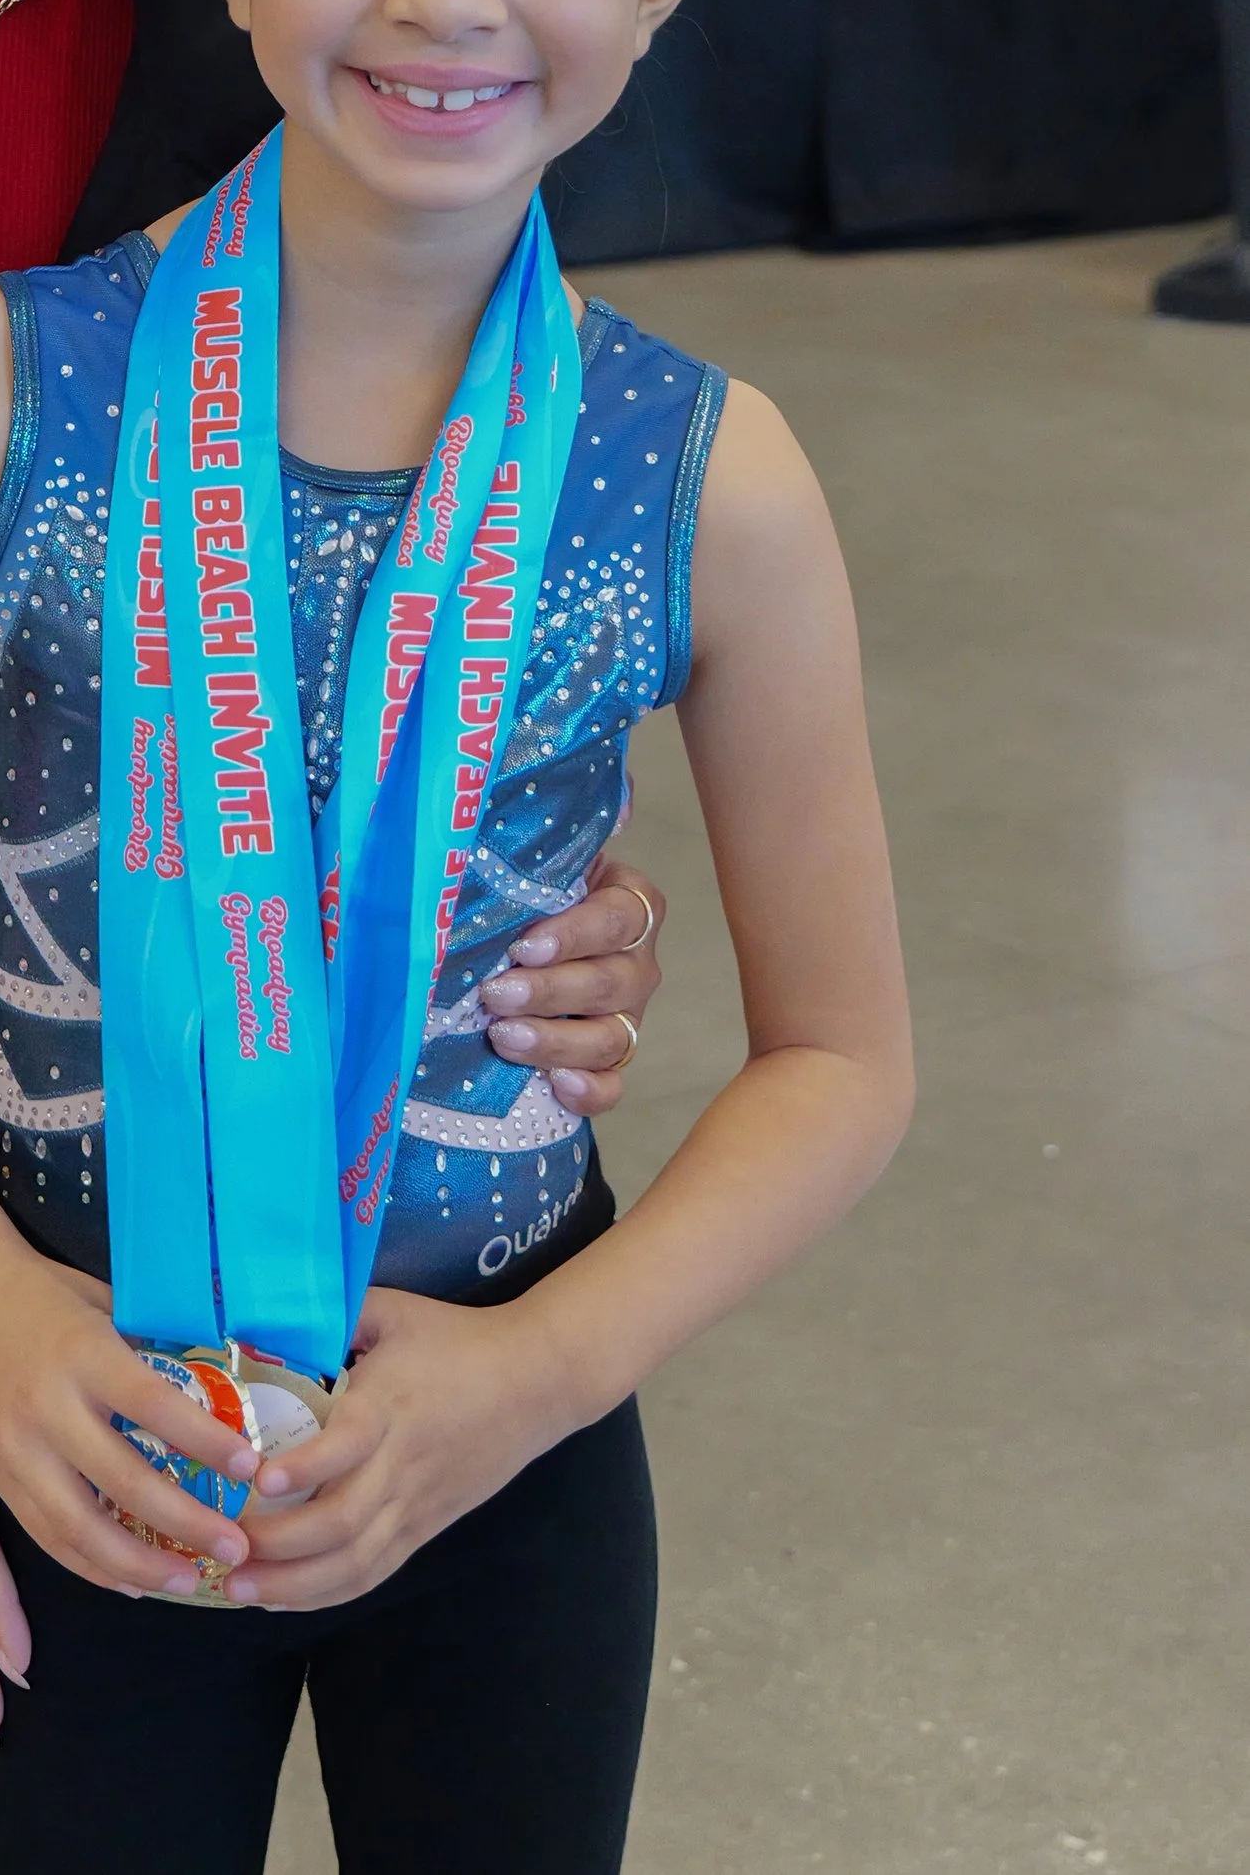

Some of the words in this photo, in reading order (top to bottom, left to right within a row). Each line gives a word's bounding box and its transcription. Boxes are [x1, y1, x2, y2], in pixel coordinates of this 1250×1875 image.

[190, 287, 243, 472] MUSCLE
[191, 486, 258, 658] BEACH
[427, 414, 474, 566] Broadway
[457, 460, 521, 642] INVITE
[123, 716, 156, 873] Broadway
[154, 712, 186, 881] Gymnastics
[205, 671, 275, 858] INVITE
[452, 657, 509, 833] BEACH
[217, 891, 260, 1062] Gymnastics
[259, 895, 293, 1056] Broadway
[338, 1071, 401, 1204] Broadwa
[152, 1356, 193, 1386] BEACH
